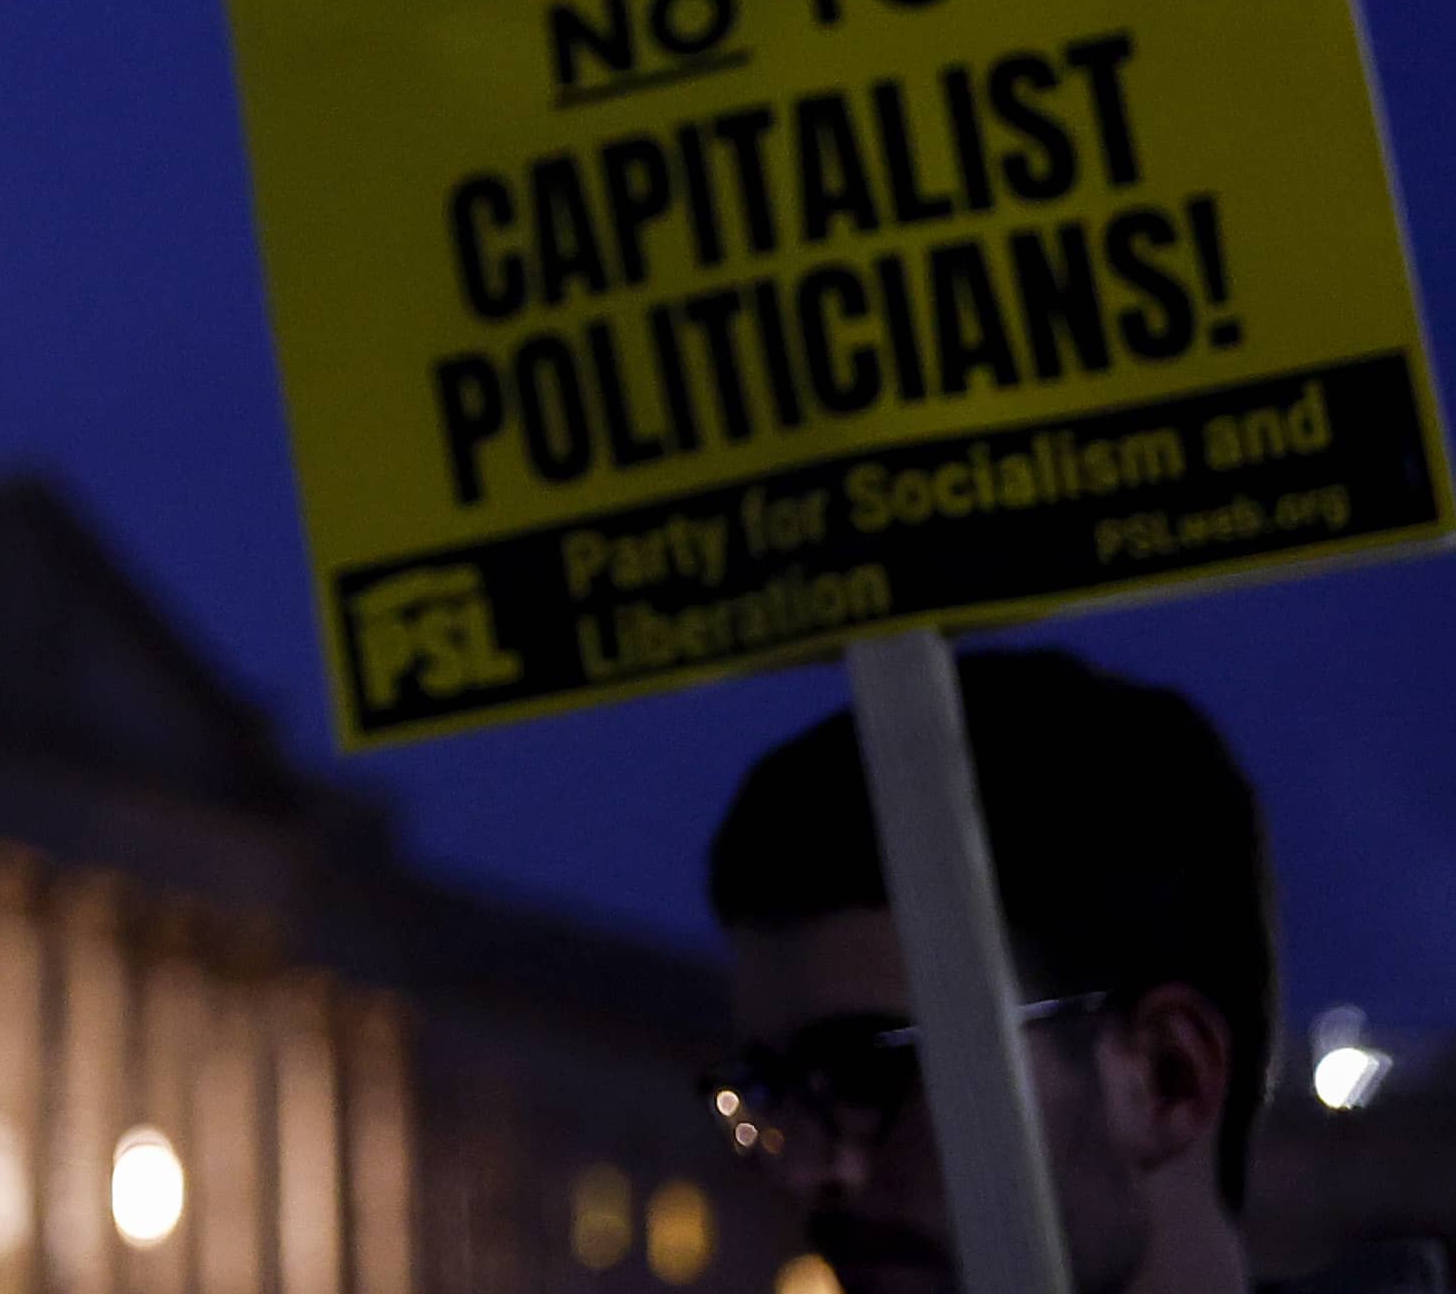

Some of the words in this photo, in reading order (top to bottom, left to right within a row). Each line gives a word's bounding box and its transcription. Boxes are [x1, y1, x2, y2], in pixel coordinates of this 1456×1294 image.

[451, 36, 1135, 318] CAPITALIST
[438, 199, 1239, 504] POLITICIANS!
[558, 509, 731, 603] Party
[738, 482, 836, 559] for
[840, 420, 1189, 538] Socialism
[1201, 376, 1335, 476] and
[572, 558, 894, 682] Liberation
